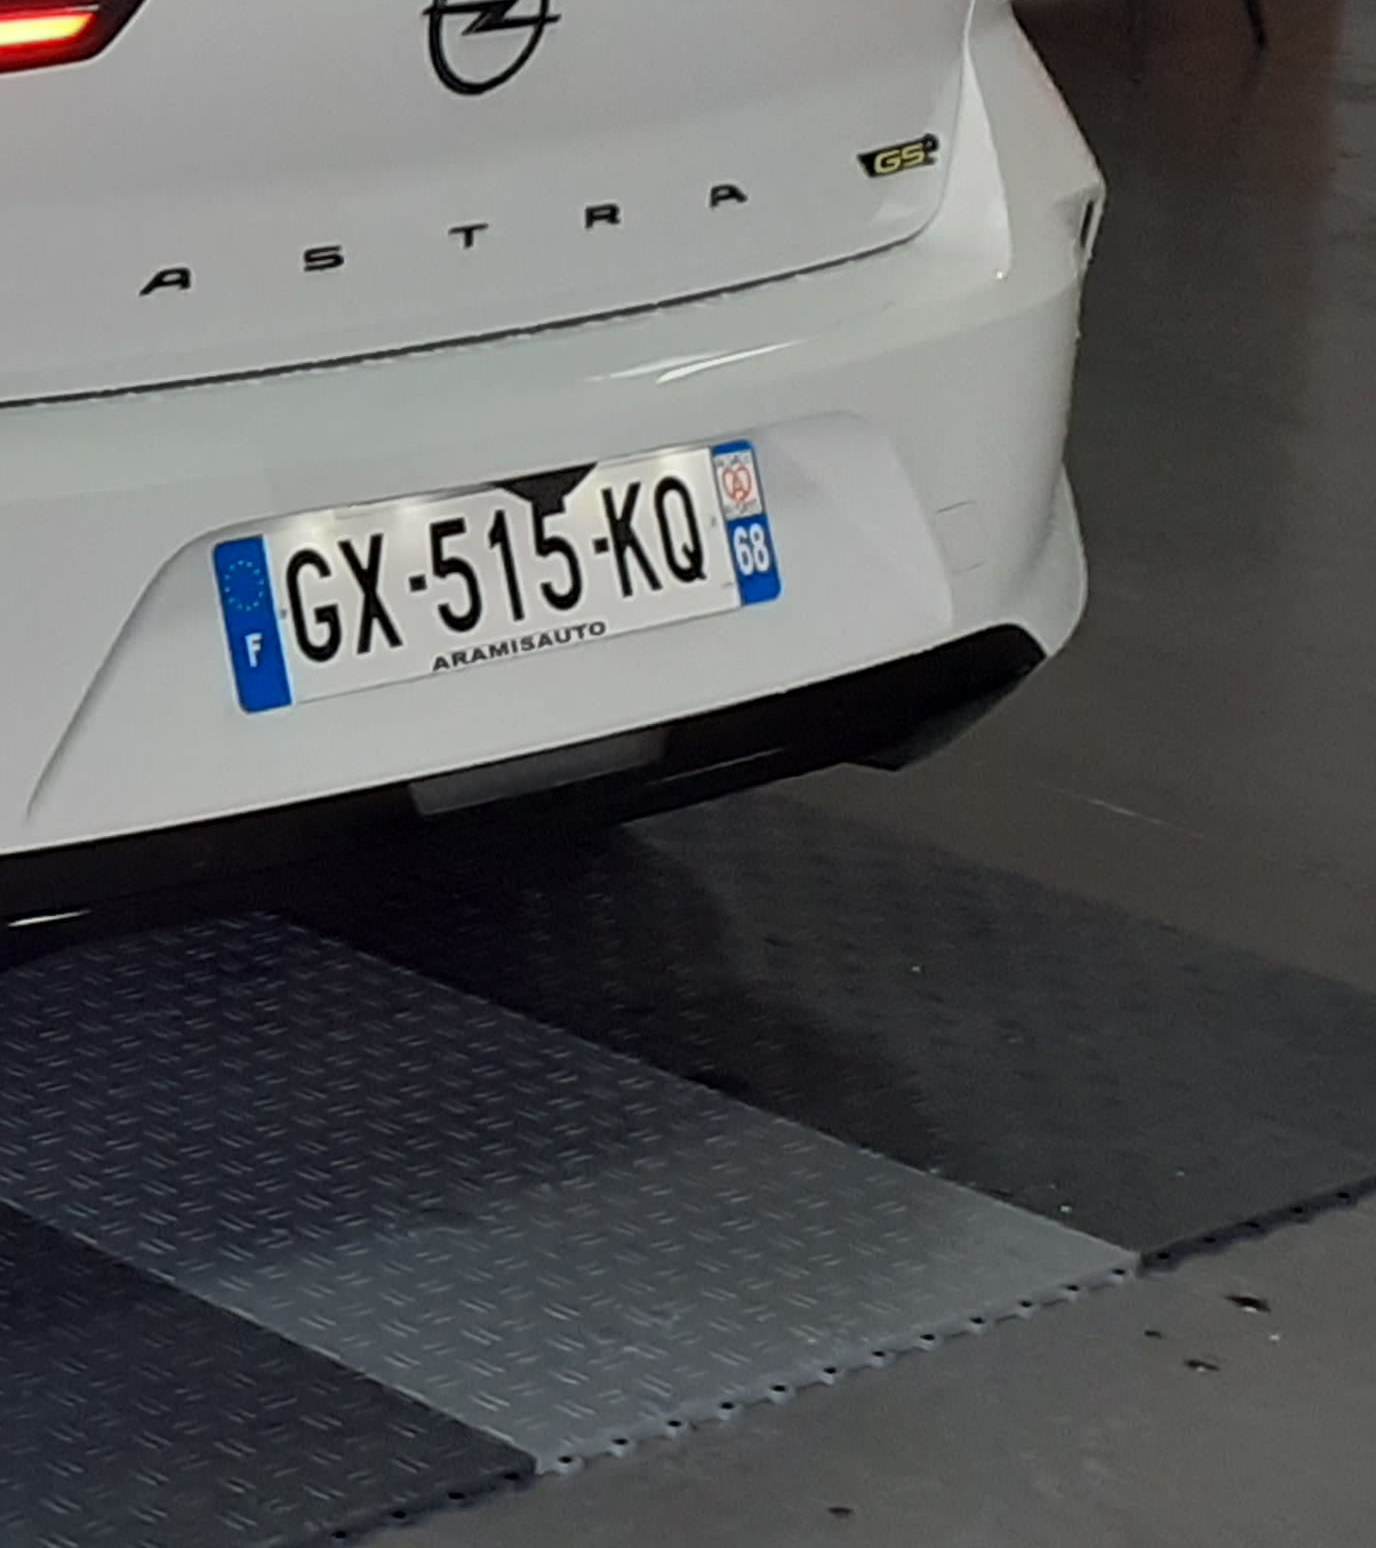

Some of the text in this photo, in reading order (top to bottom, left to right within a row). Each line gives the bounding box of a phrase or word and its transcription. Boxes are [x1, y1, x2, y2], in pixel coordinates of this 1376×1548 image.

[139, 183, 748, 295] ASTRA
[285, 476, 707, 663] GX-515-KQ
[733, 523, 769, 575] 68
[245, 633, 262, 667] F
[432, 621, 606, 671] ARAMISAUTO
